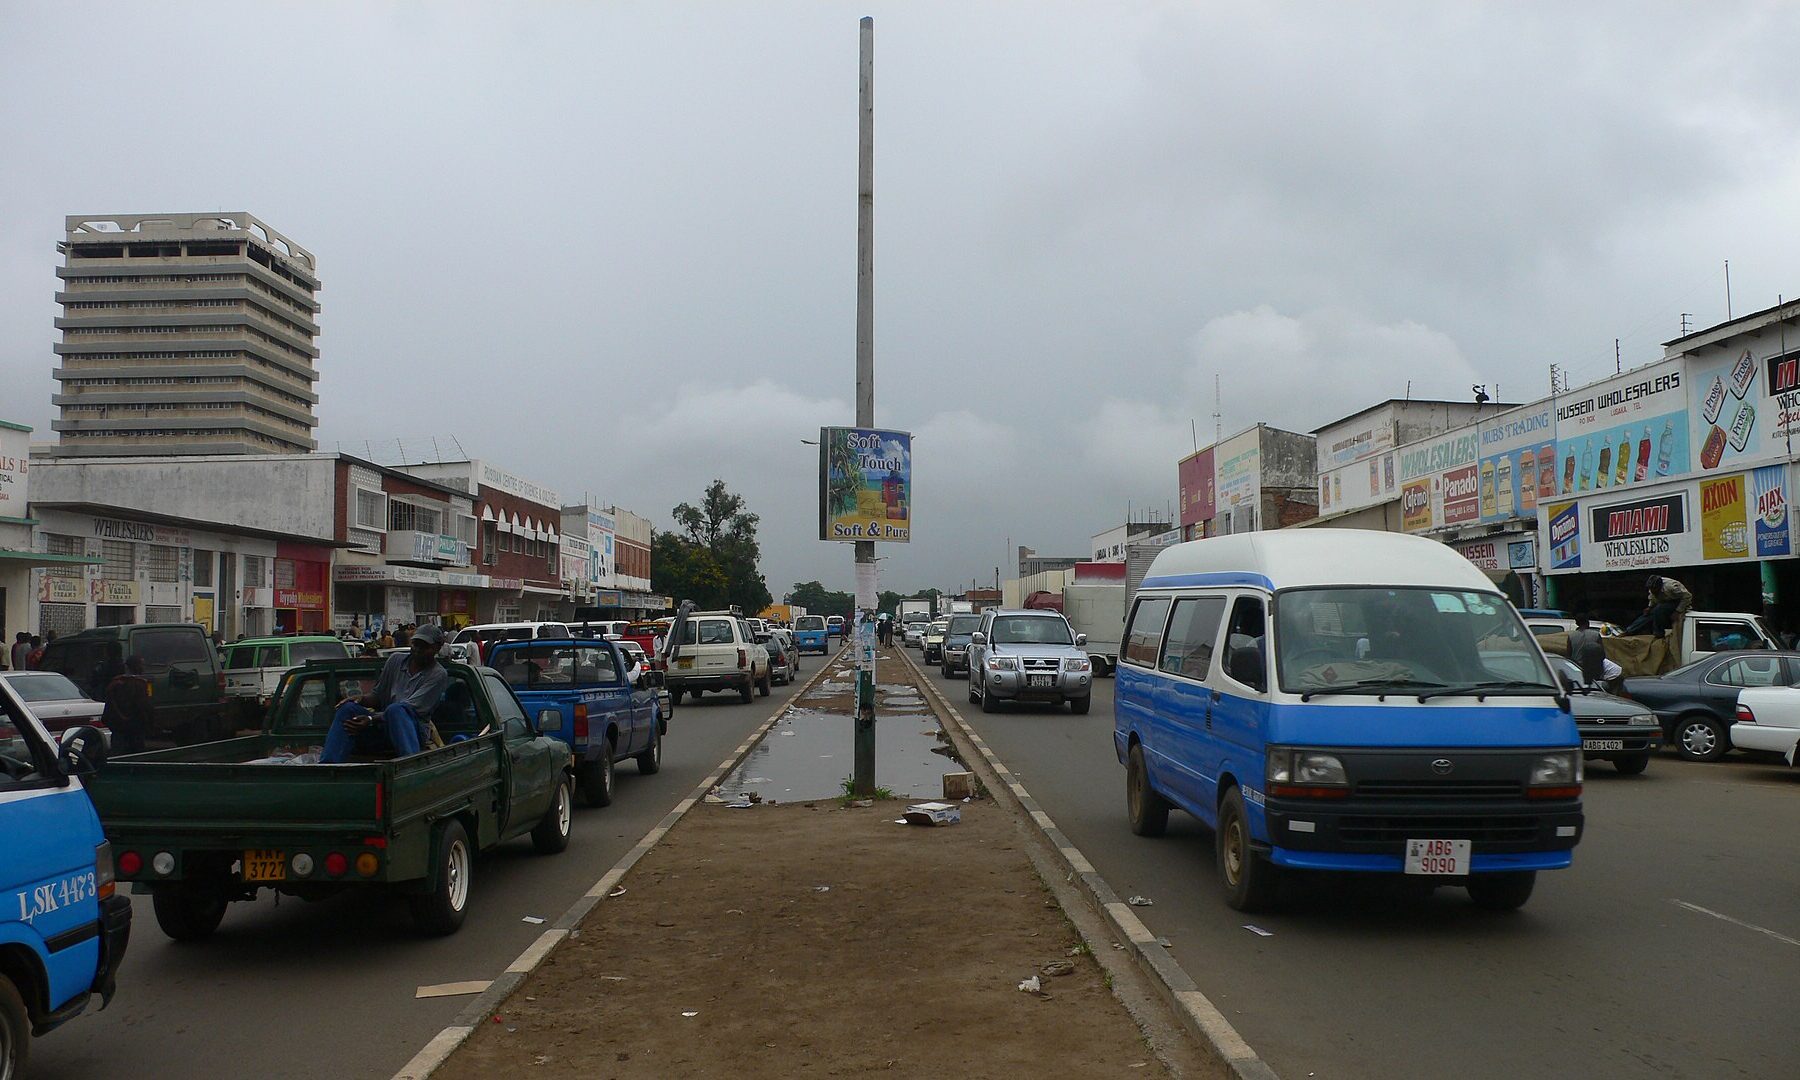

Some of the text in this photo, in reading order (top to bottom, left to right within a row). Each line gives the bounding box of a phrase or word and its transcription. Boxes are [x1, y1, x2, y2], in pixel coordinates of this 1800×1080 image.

[1776, 357, 1800, 391] M
[1556, 371, 1680, 422] HUSSEIN WHOLESALERS
[1481, 411, 1549, 446] MUBS TRADING
[1732, 405, 1749, 437] Protex
[847, 432, 882, 449] Soft
[858, 453, 901, 472] Touch
[1401, 433, 1477, 480] WHOLESALERS
[1703, 479, 1739, 513] AXION
[1758, 486, 1785, 517] AJAX
[94, 518, 155, 542] WHOLESALERS
[834, 521, 908, 539] Soft & Pure
[1608, 504, 1669, 538] MIAMI
[1604, 537, 1669, 557] WHOLESALERS
[51, 580, 77, 592] Vanilla
[107, 582, 133, 595] Vanilla
[1602, 740, 1619, 750] 1402
[1426, 840, 1453, 856] ABG
[250, 861, 286, 878] 3727
[1421, 857, 1456, 873] 9090
[17, 872, 96, 925] LSK 4473
